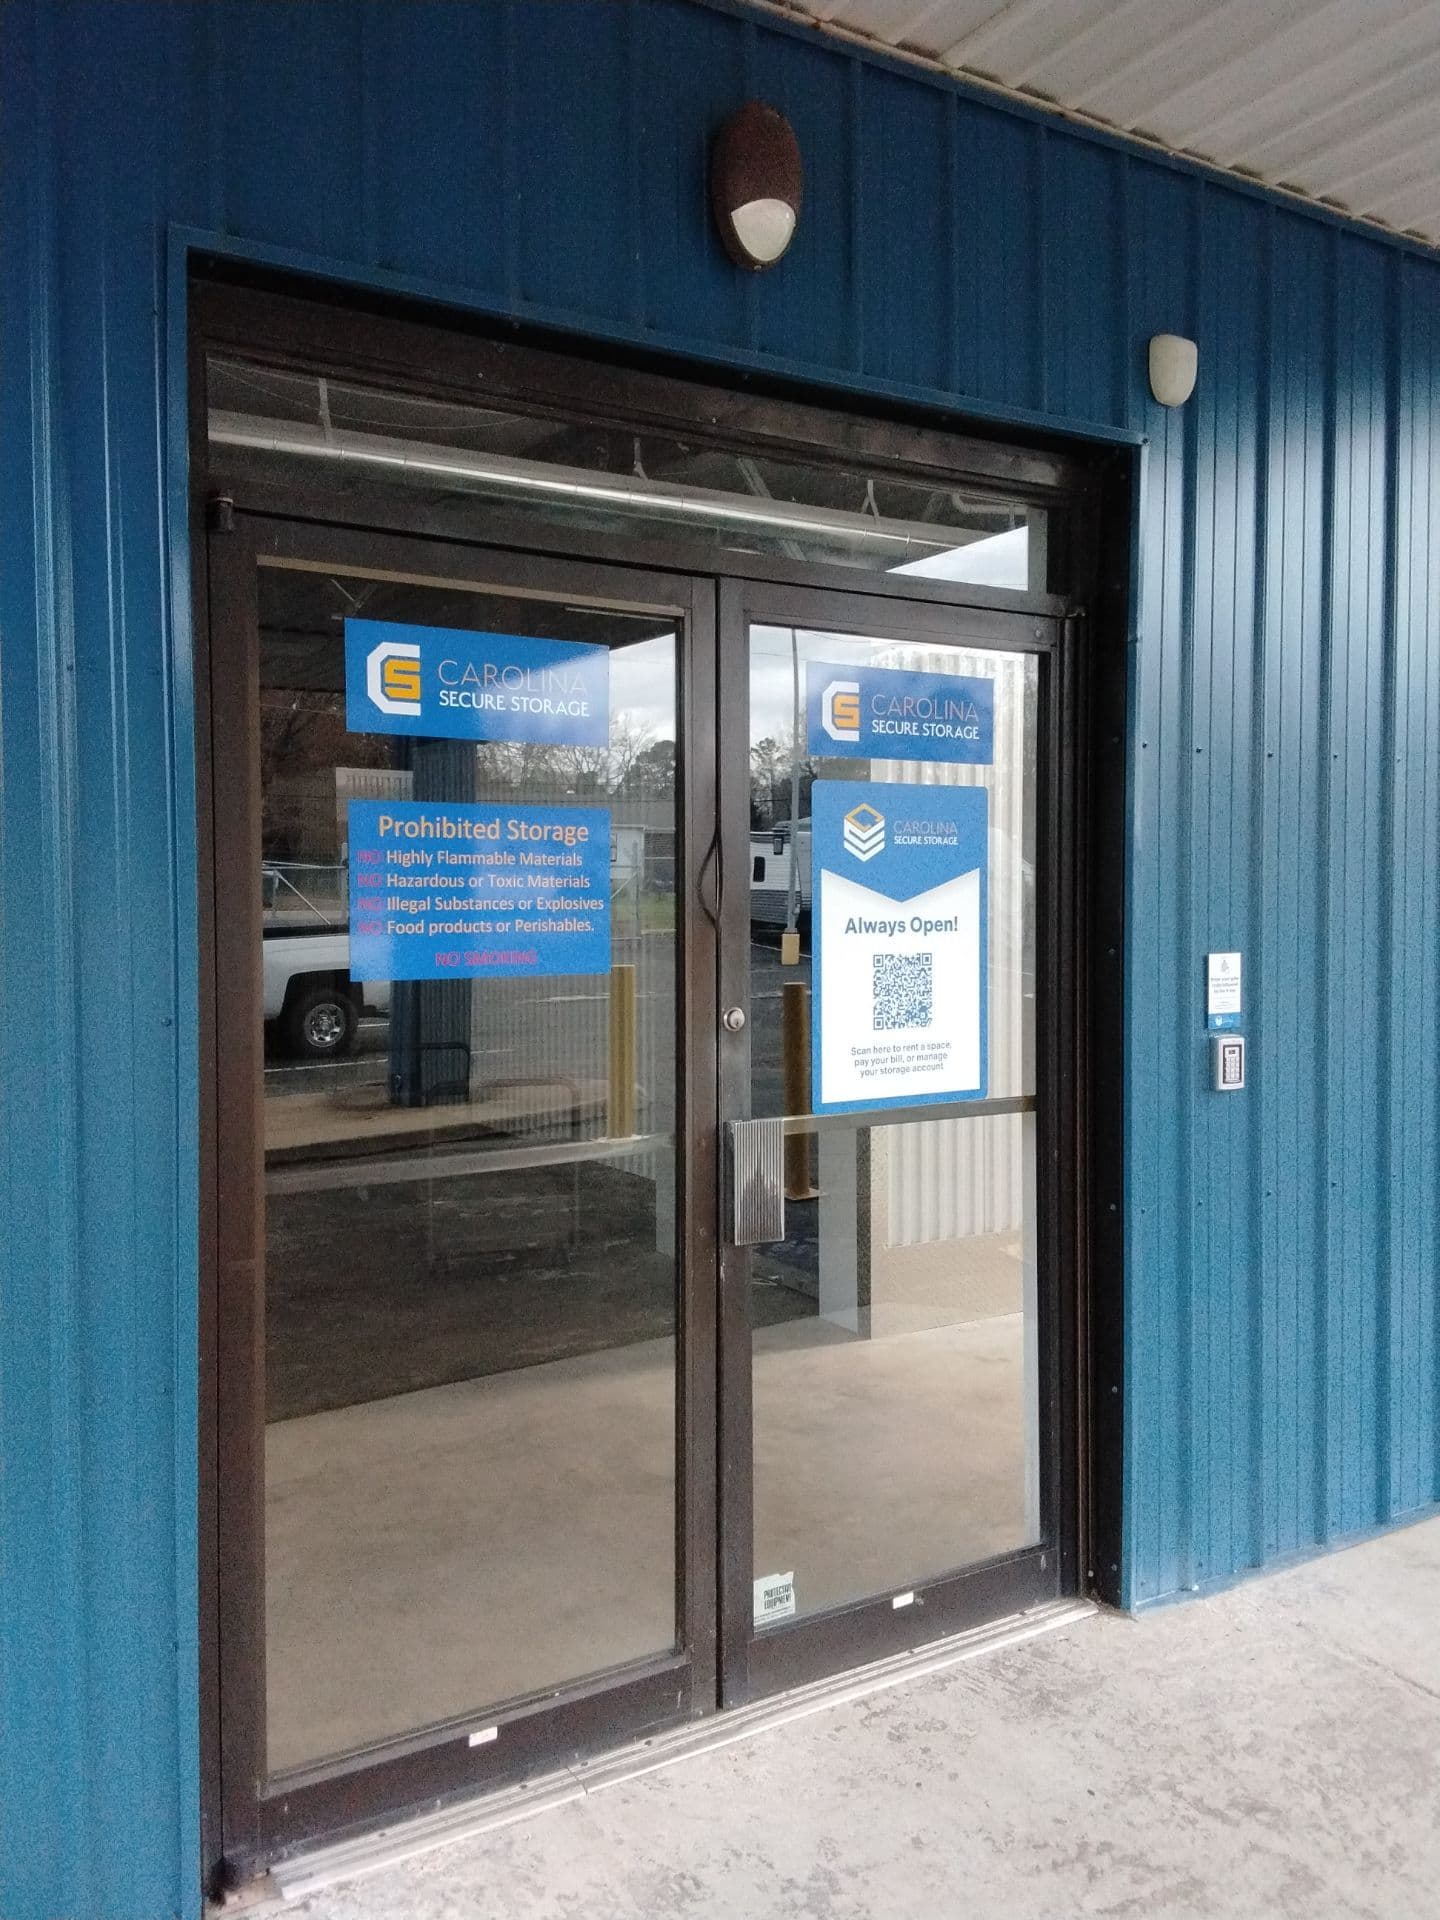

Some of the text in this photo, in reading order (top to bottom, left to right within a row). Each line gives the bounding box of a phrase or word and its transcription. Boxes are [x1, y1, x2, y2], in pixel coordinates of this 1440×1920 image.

[438, 660, 588, 695] CAROLINA
[439, 690, 590, 718] SECURE STORAGE
[871, 694, 979, 722] CAROLINA
[871, 719, 979, 740] SECURE STORAGE
[379, 815, 589, 846] Prohibited Storage
[893, 820, 958, 835] CAROLINA
[894, 835, 958, 847] SECURE STORAGE
[387, 849, 432, 867] Highly
[437, 850, 515, 866] Flammable
[520, 852, 583, 867] Materials
[357, 873, 590, 889] NO Hazardous or Toxic Materials
[387, 896, 431, 914] Illegal
[434, 897, 515, 911] Substances
[518, 899, 533, 910] or
[536, 896, 605, 913] Explosives
[387, 920, 424, 935] Food
[429, 918, 493, 936] products
[495, 921, 511, 933] or
[515, 917, 595, 934] Perishables.
[845, 916, 958, 937] Always Open!
[435, 951, 461, 968] NO
[851, 1047, 871, 1056] Scan
[873, 1045, 891, 1054] here
[893, 1045, 901, 1053] to
[903, 1043, 919, 1052] rent
[854, 1058, 869, 1068] pay
[870, 1057, 888, 1067] your
[890, 1054, 905, 1063] bill,
[917, 1052, 948, 1062] manage
[860, 1063, 944, 1078] your storage account
